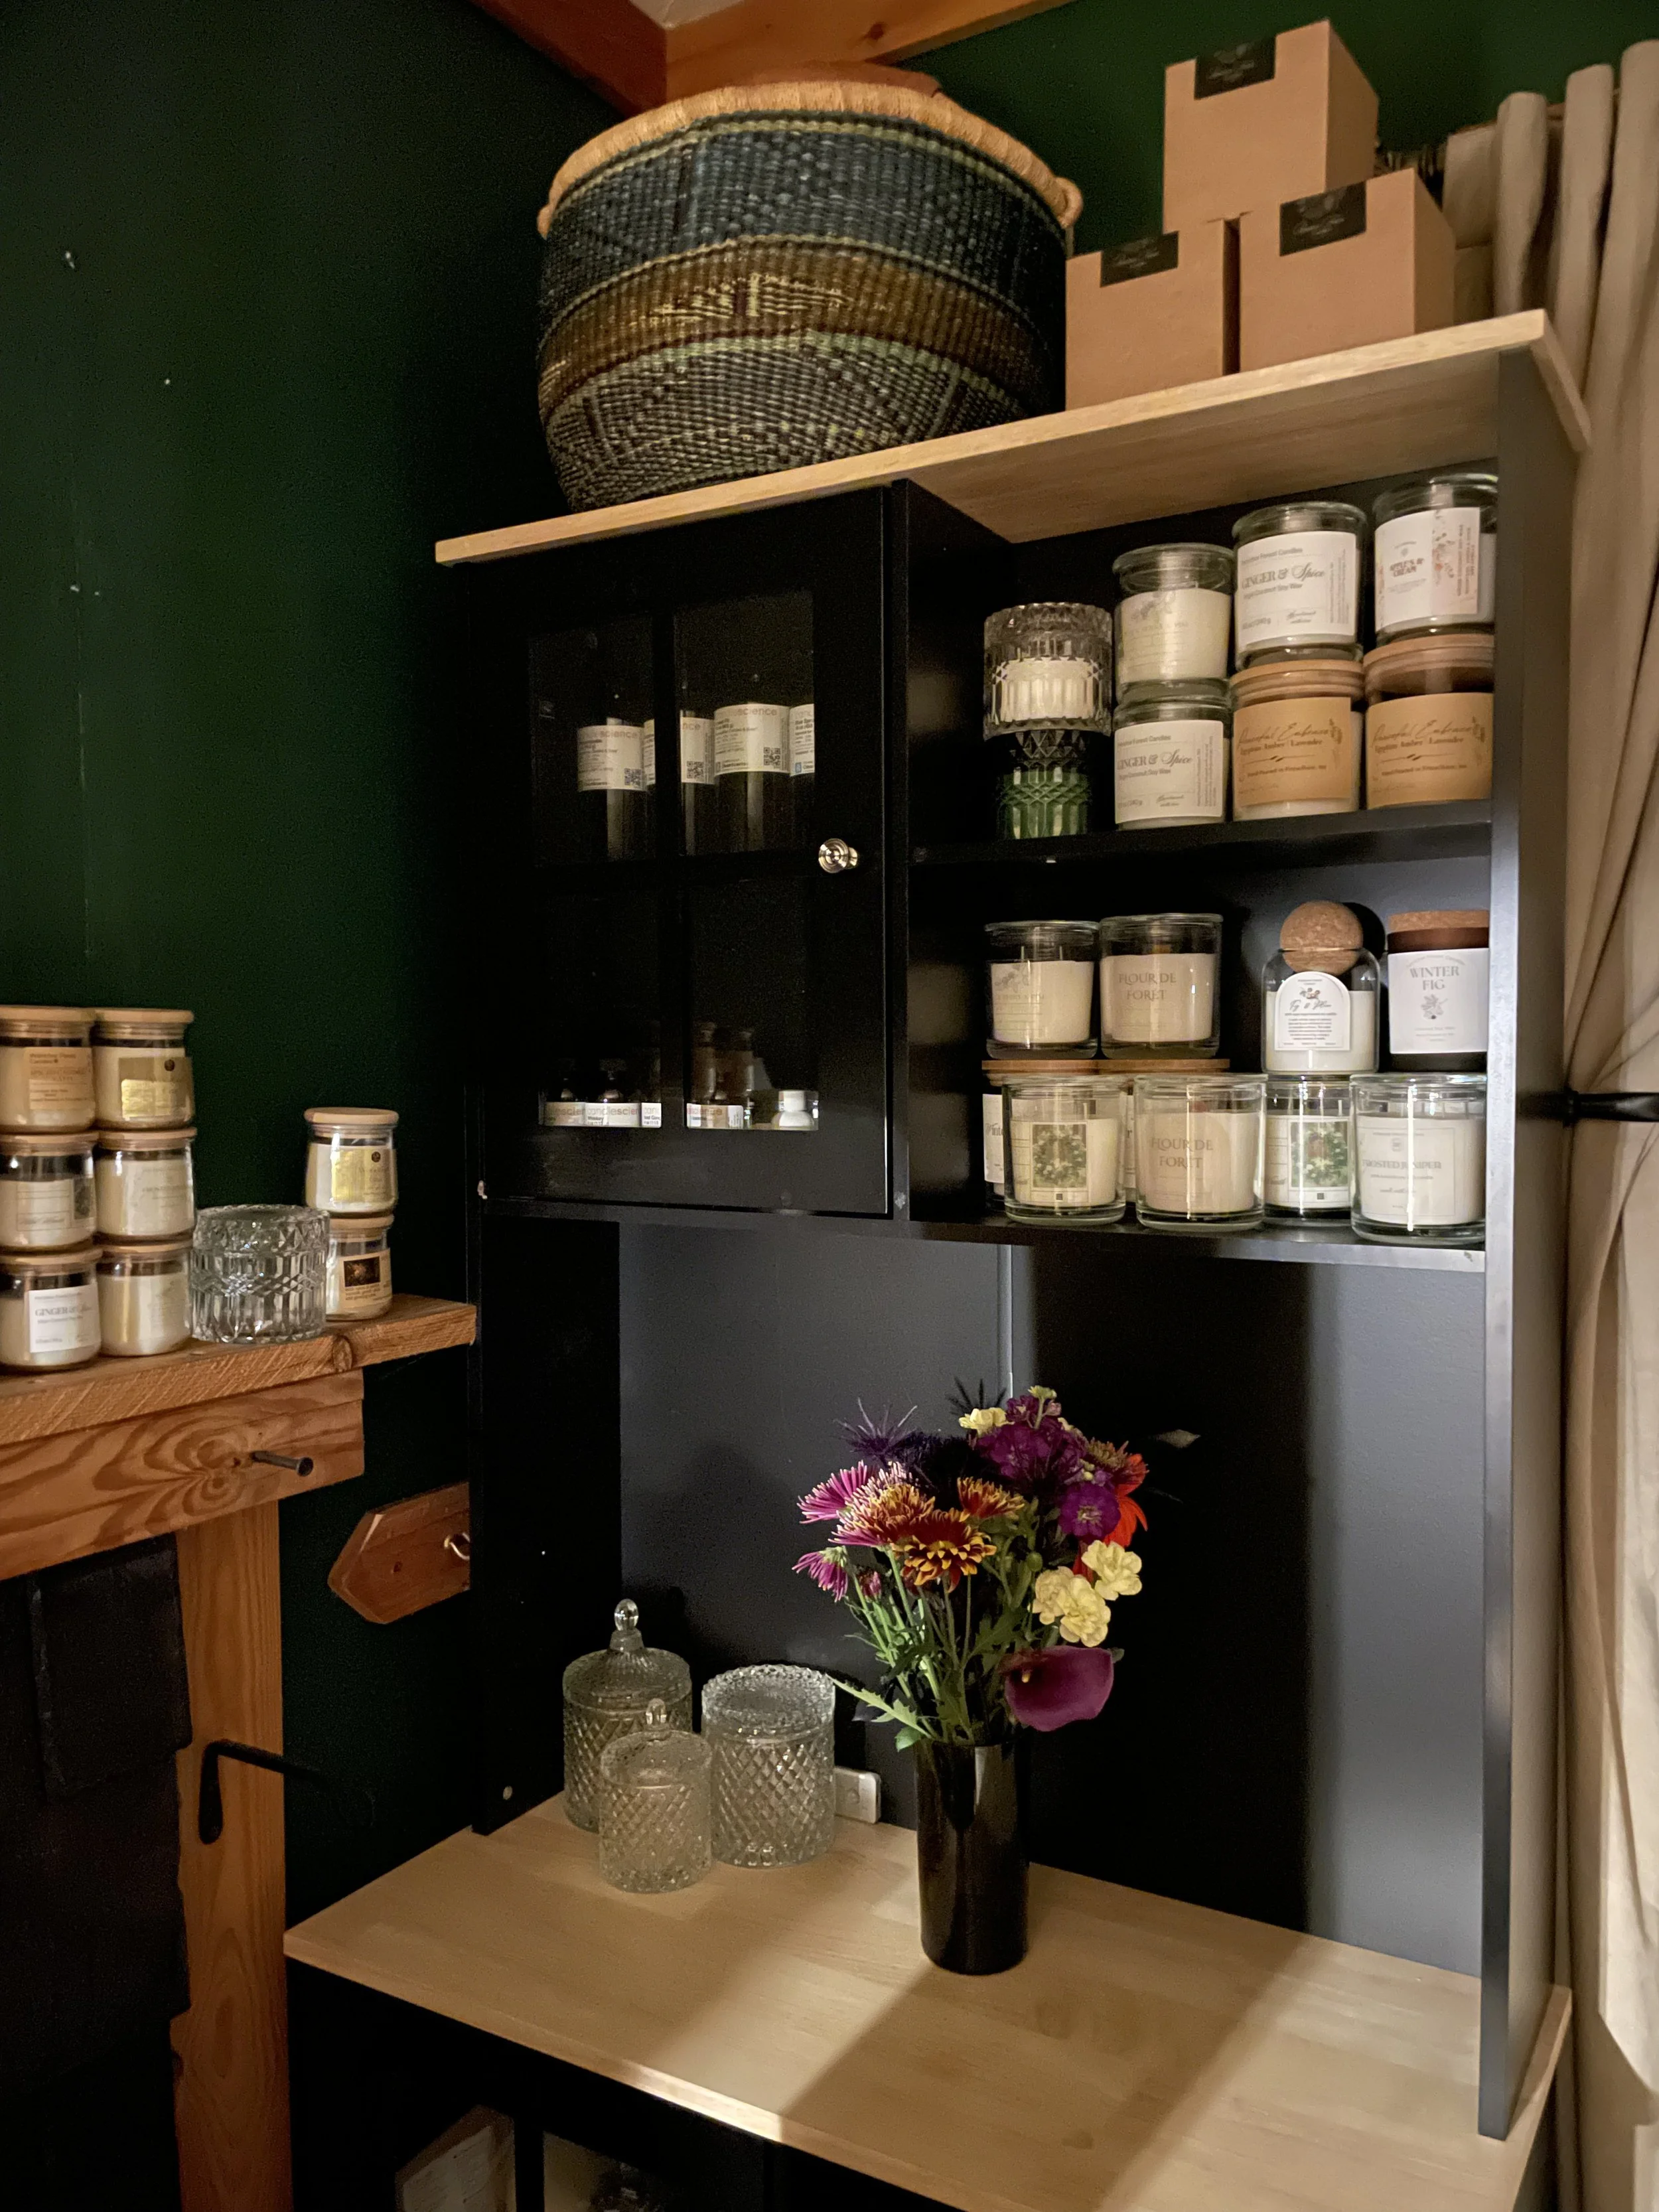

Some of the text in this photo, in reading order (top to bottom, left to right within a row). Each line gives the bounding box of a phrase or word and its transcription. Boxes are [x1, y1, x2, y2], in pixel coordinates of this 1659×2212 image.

[1277, 568, 1289, 580] &
[1291, 562, 1326, 582] Spice
[1148, 754, 1159, 765] &
[1161, 749, 1193, 767] Spice
[1159, 972, 1177, 984] DE
[1409, 966, 1460, 979] WINTER
[1422, 979, 1445, 991] FIG
[1194, 1139, 1214, 1151] DE
[35, 1306, 68, 1317] GINGER
